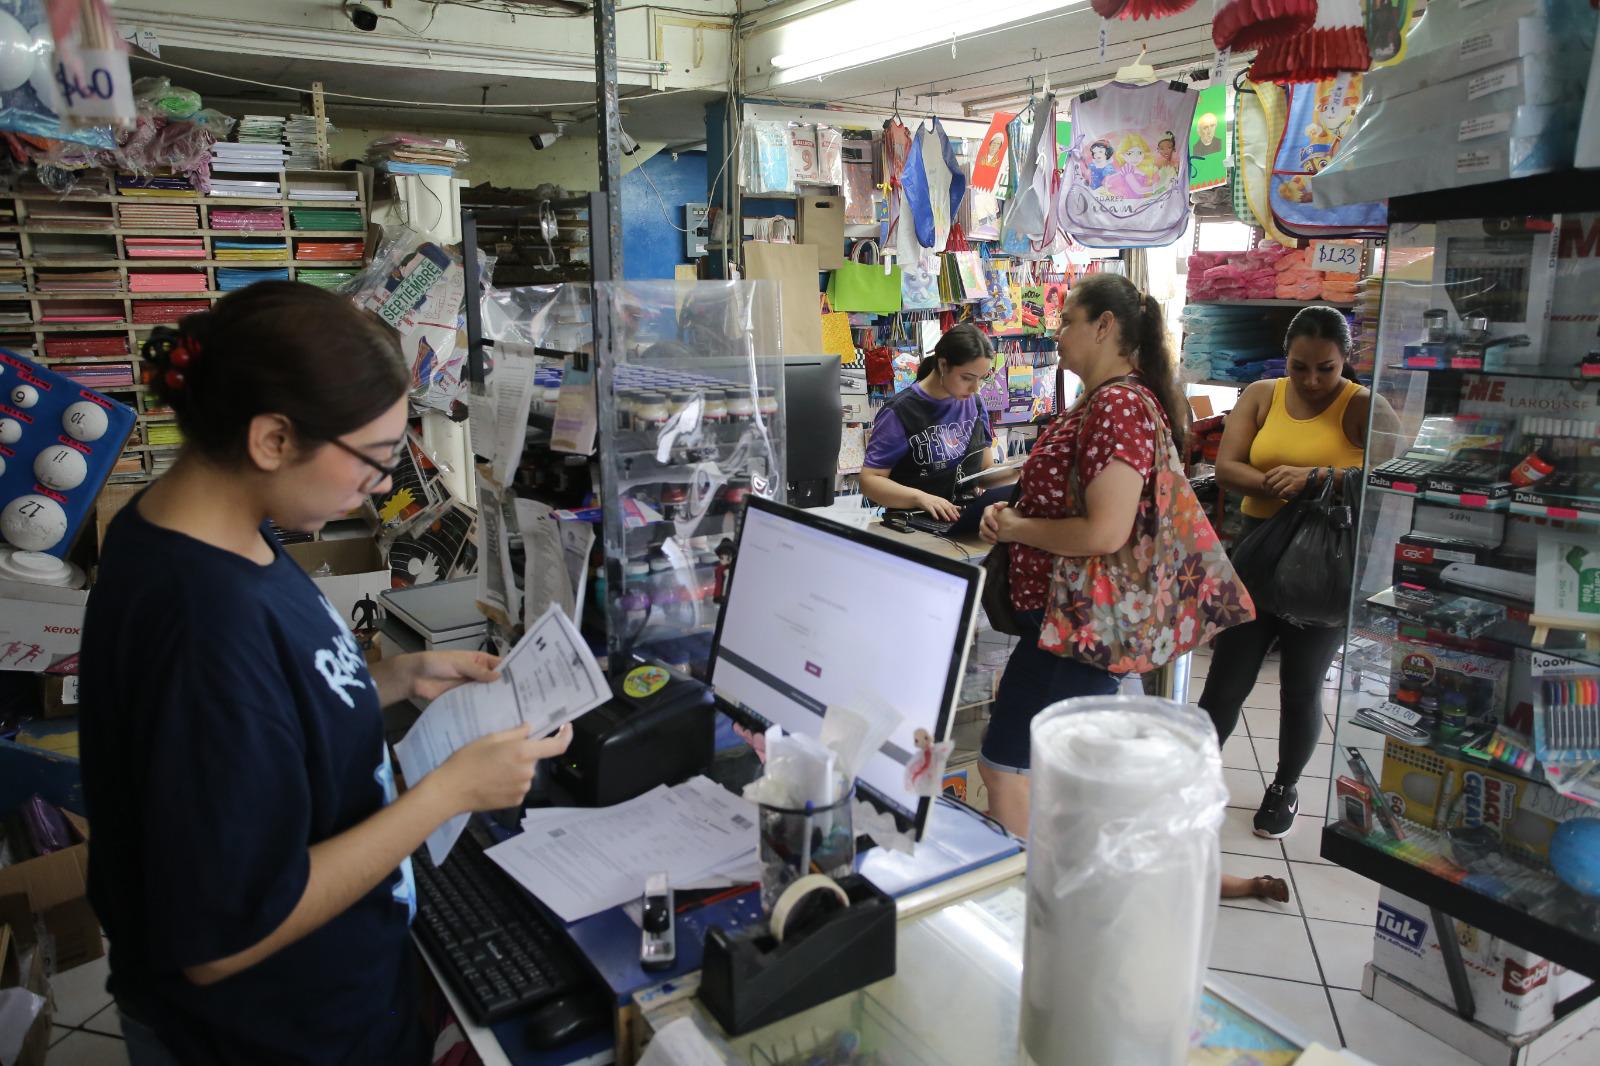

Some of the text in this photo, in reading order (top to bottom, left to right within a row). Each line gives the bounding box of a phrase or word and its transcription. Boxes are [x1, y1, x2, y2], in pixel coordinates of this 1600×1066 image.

[1319, 244, 1356, 266] $123
[383, 262, 440, 321] SEPTIEMBRE
[1370, 476, 1390, 487] Delta
[1430, 481, 1454, 491] Delta
[1515, 492, 1544, 504] Delta
[19, 500, 45, 518] 12
[43, 624, 80, 635] xerox
[1378, 909, 1419, 942] Tuk
